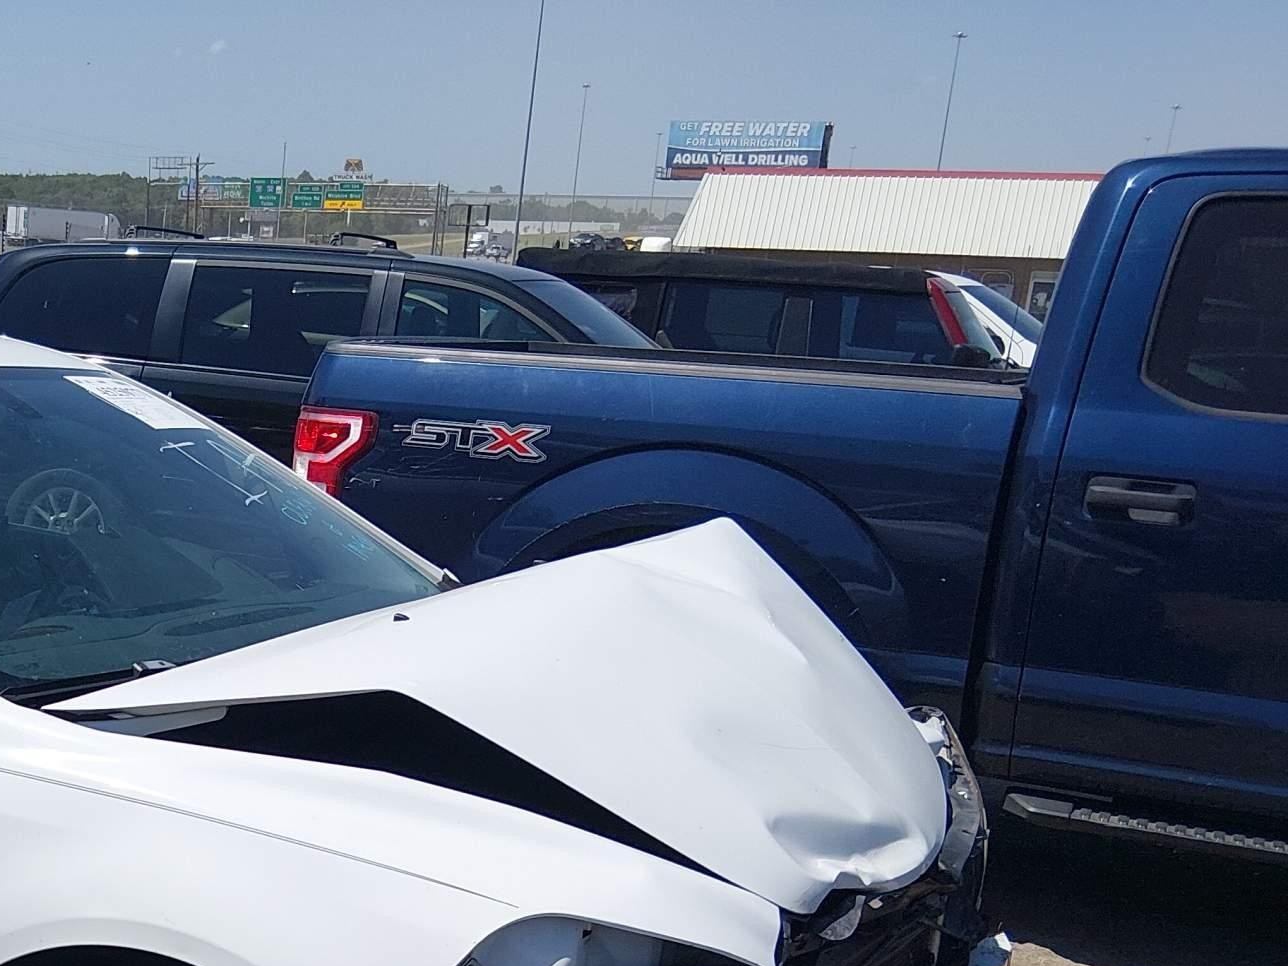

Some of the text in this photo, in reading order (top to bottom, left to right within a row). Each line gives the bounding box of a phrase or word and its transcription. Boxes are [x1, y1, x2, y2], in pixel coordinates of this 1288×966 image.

[680, 122, 810, 137] GET FREE WATER
[686, 138, 800, 147] FOR LAWN IRRIGATION
[673, 153, 809, 166] AQUA WELL DRILLING
[400, 418, 552, 464] STX
